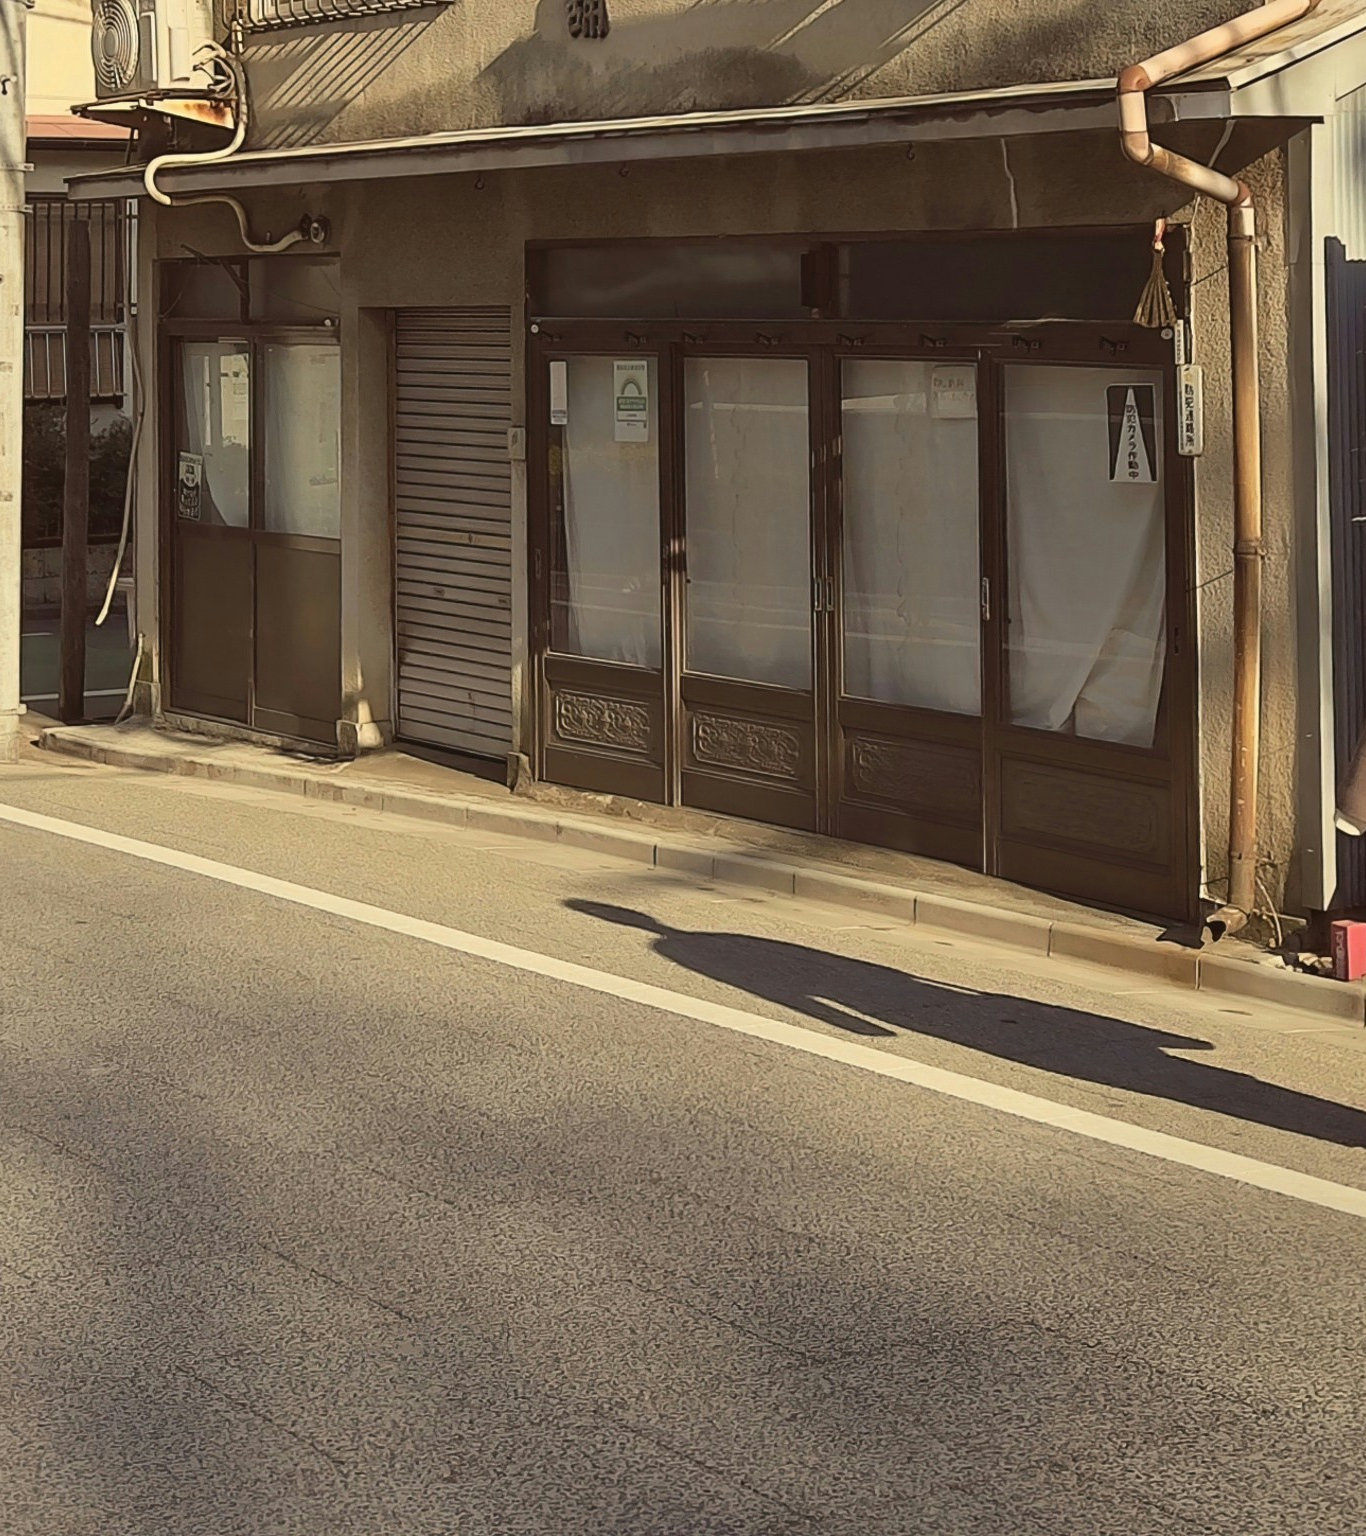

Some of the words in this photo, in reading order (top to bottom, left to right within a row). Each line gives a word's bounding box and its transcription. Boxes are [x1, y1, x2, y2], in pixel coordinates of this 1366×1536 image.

[1126, 404, 1139, 479] 防犯カメラ作動中
